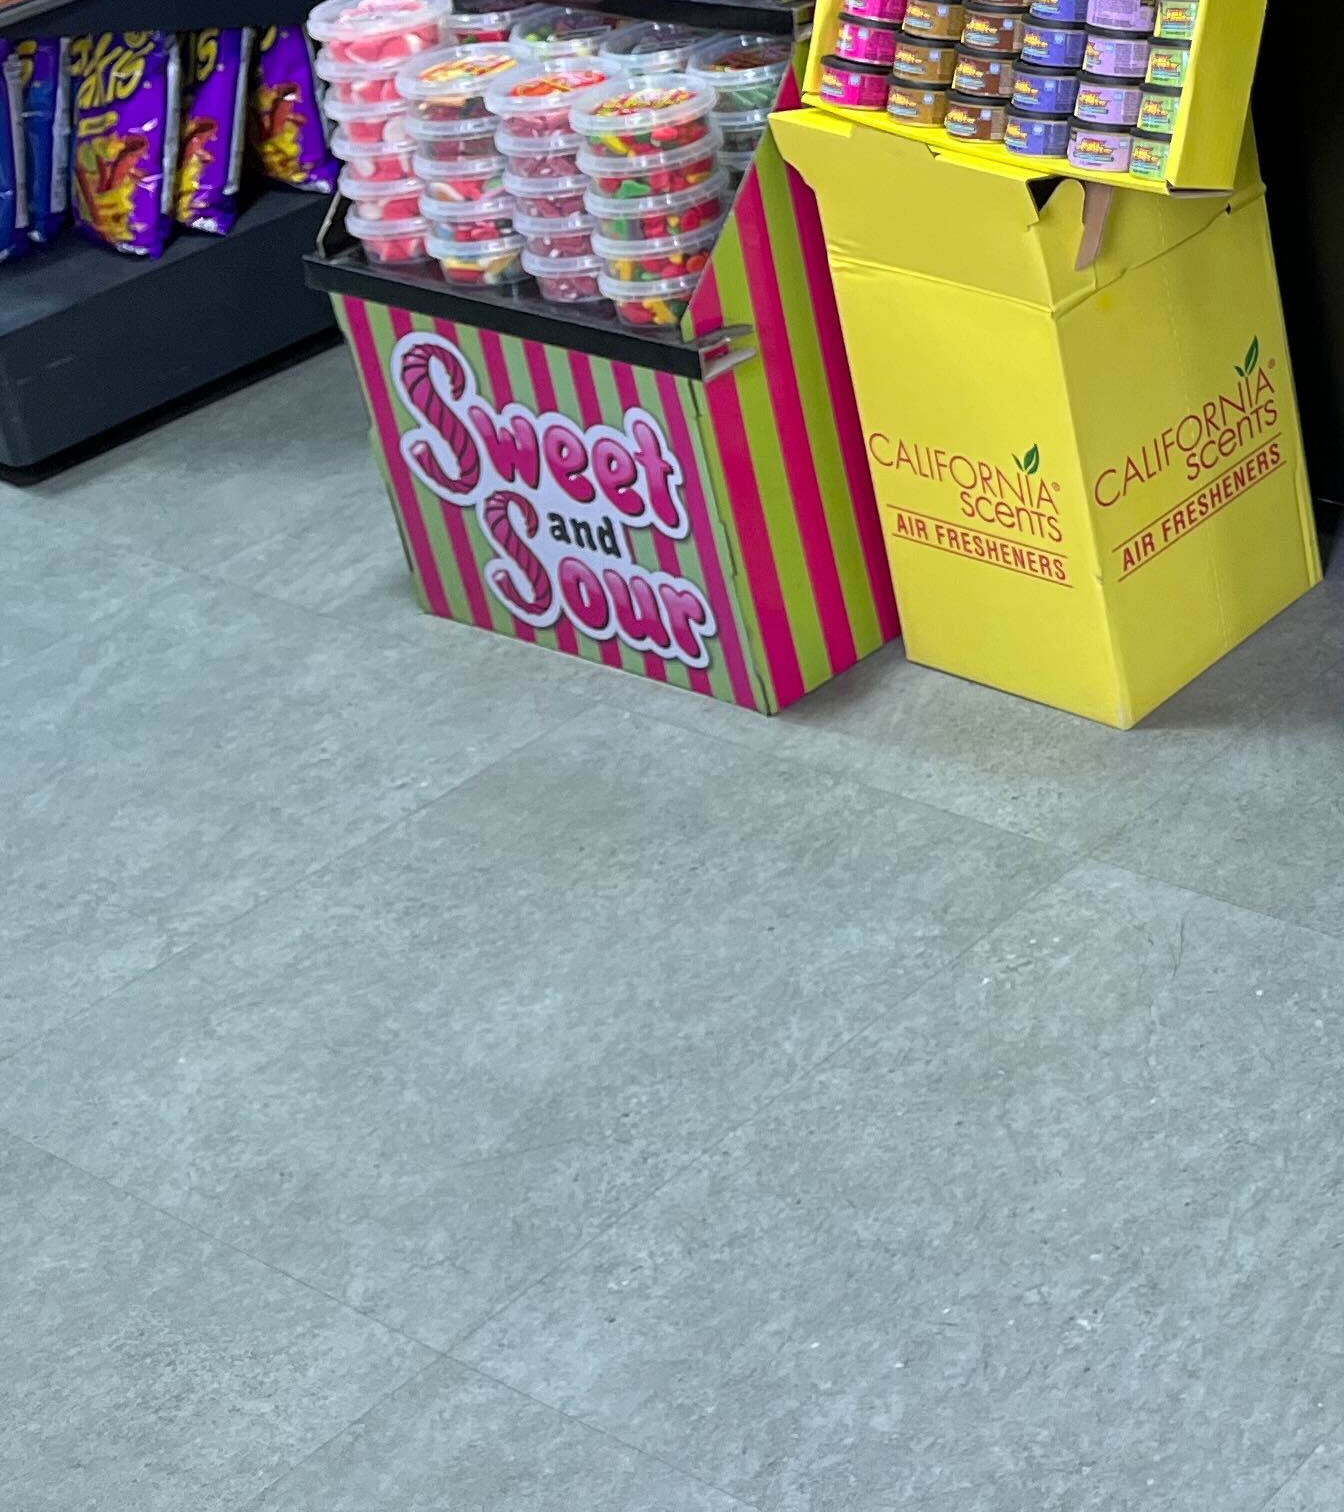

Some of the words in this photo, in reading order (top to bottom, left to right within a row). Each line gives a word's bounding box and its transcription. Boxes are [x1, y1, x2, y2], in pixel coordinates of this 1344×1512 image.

[400, 341, 680, 533] Sweet
[867, 431, 1060, 515] CALIFORNIA
[1094, 366, 1276, 508] CALIFORNIA
[548, 508, 622, 559] and
[896, 512, 929, 542] AIR
[936, 525, 1067, 582] FRESHENERS
[1122, 536, 1156, 573] AIR
[1160, 441, 1282, 544] FRESHENERS
[483, 489, 706, 660] Sour
